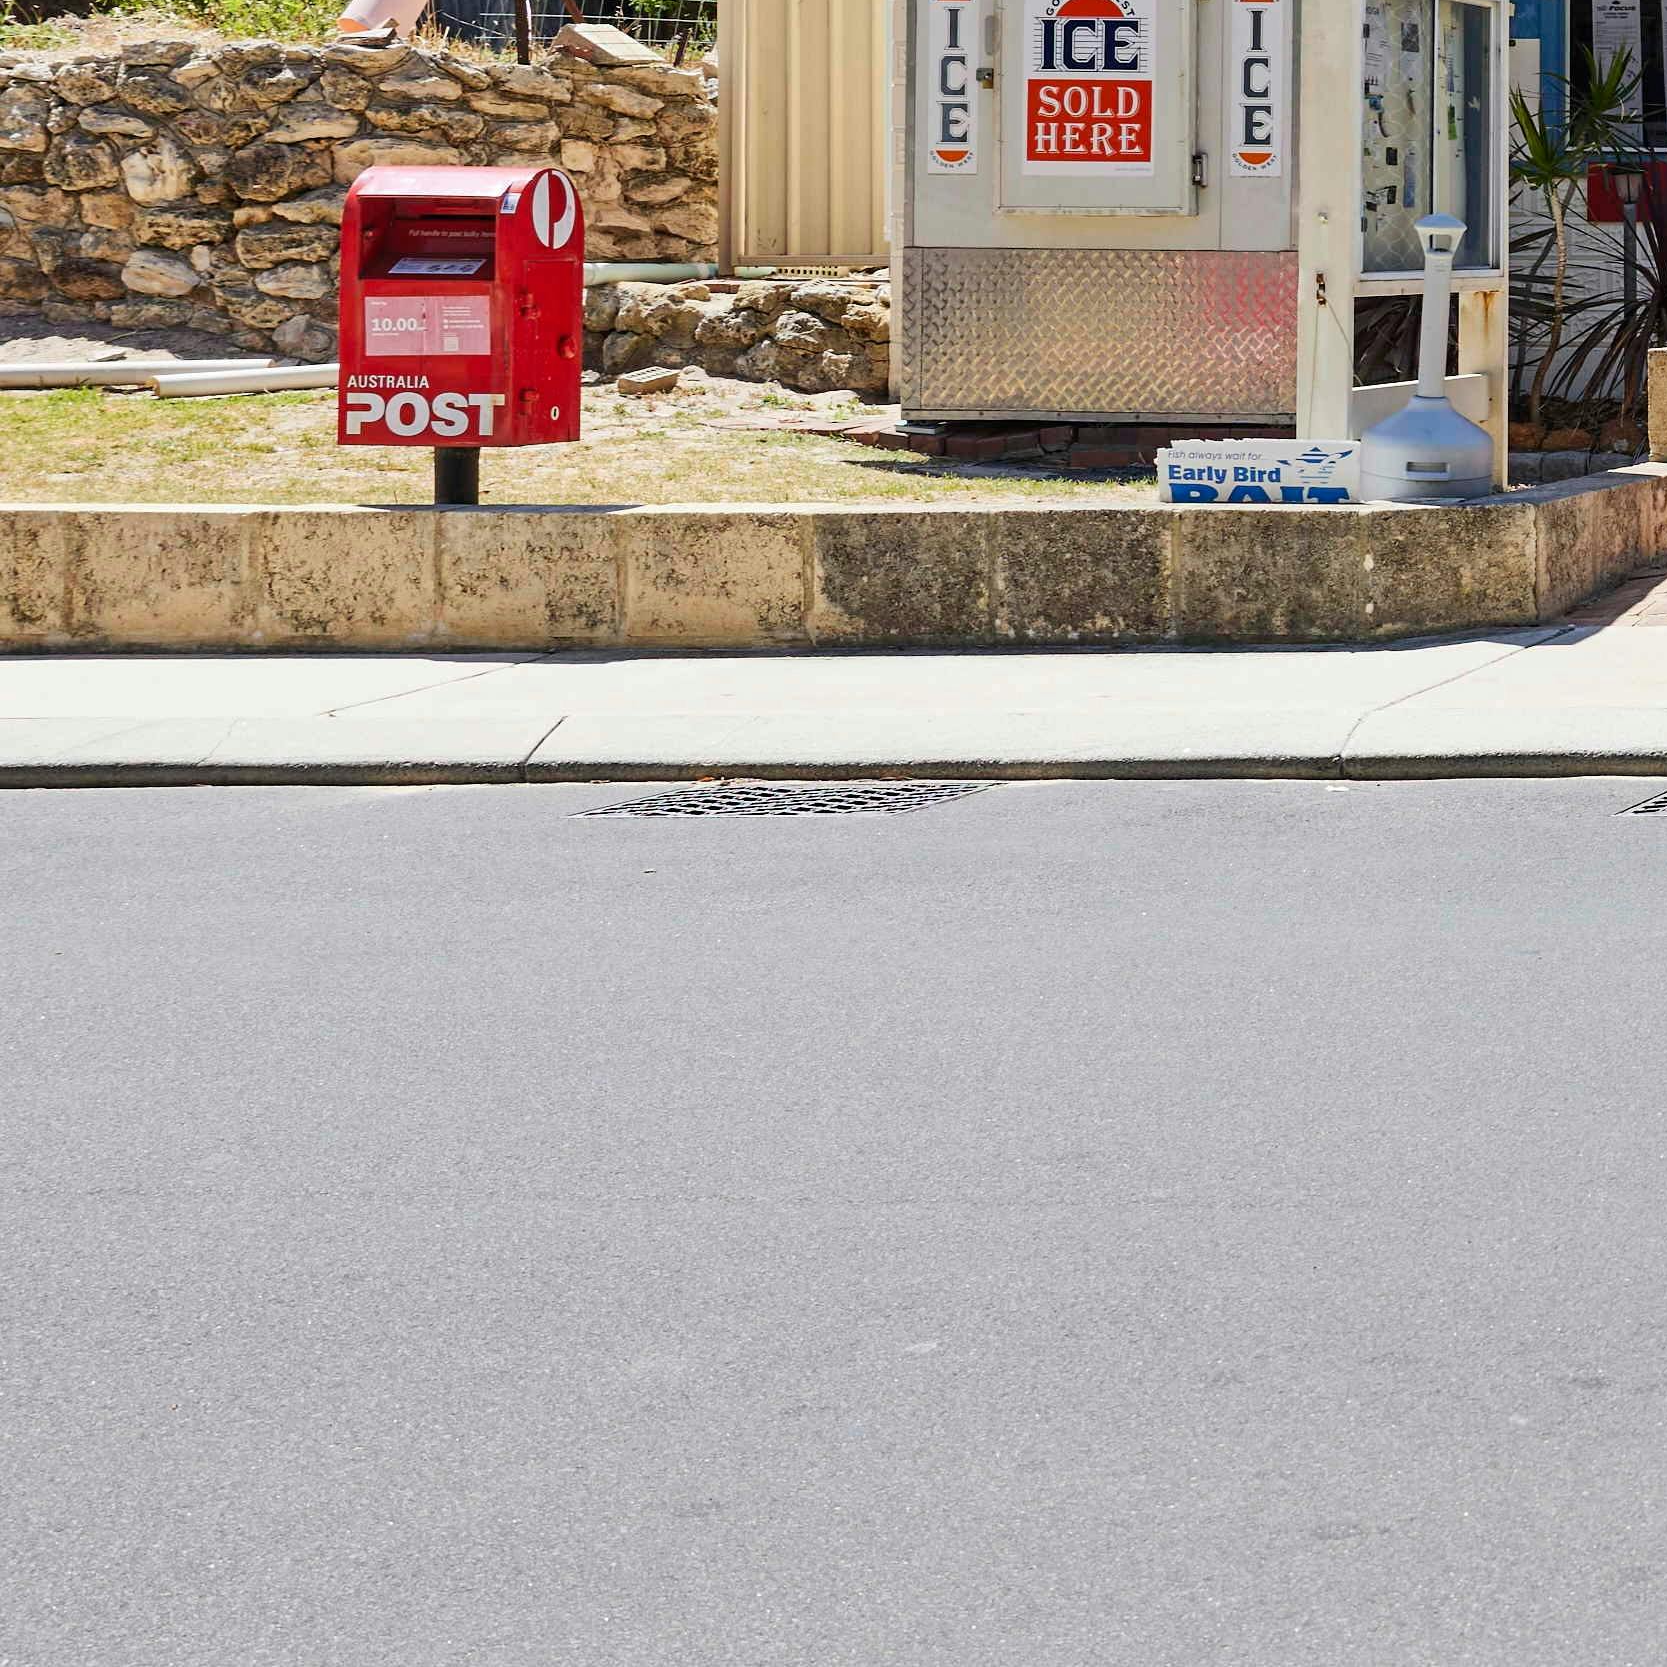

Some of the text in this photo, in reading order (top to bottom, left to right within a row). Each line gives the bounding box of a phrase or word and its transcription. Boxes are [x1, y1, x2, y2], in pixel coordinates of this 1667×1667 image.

[1035, 17, 1141, 72] ICE
[1037, 85, 1141, 118] SOLD
[1034, 122, 1144, 156] HERE
[347, 375, 430, 389] AUSTRALIA
[346, 392, 505, 437] POST
[1168, 451, 1186, 459] Fish
[1189, 451, 1222, 461] always
[1225, 451, 1246, 461] wait
[1168, 464, 1281, 484] Early Bird
